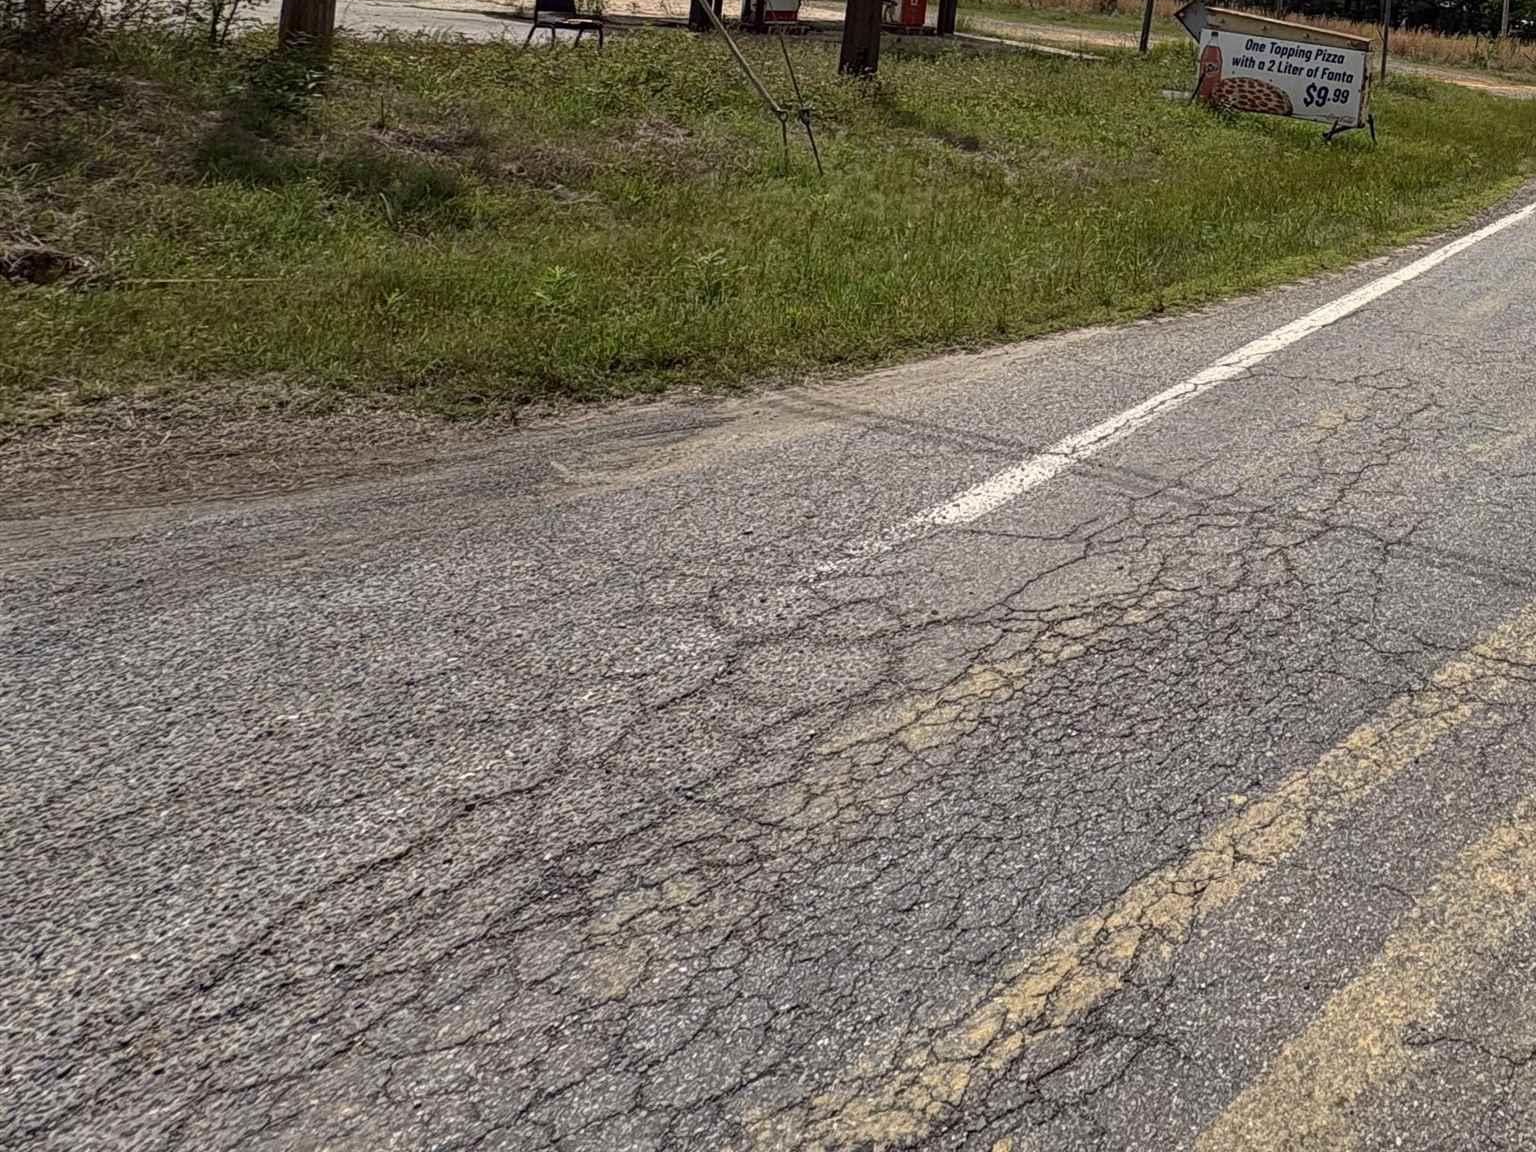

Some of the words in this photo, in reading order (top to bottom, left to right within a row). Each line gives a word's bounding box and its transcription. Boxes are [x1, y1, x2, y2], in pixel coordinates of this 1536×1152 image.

[1245, 38, 1266, 53] One
[1270, 42, 1313, 62] Topping
[1314, 49, 1345, 64] Pizza
[1232, 55, 1256, 68] with
[1257, 60, 1266, 71] a
[1267, 60, 1276, 72] 2
[1277, 61, 1305, 76] Liter
[1306, 66, 1321, 78] of
[1321, 67, 1354, 84] Fanta
[1303, 82, 1350, 107] $9.99
